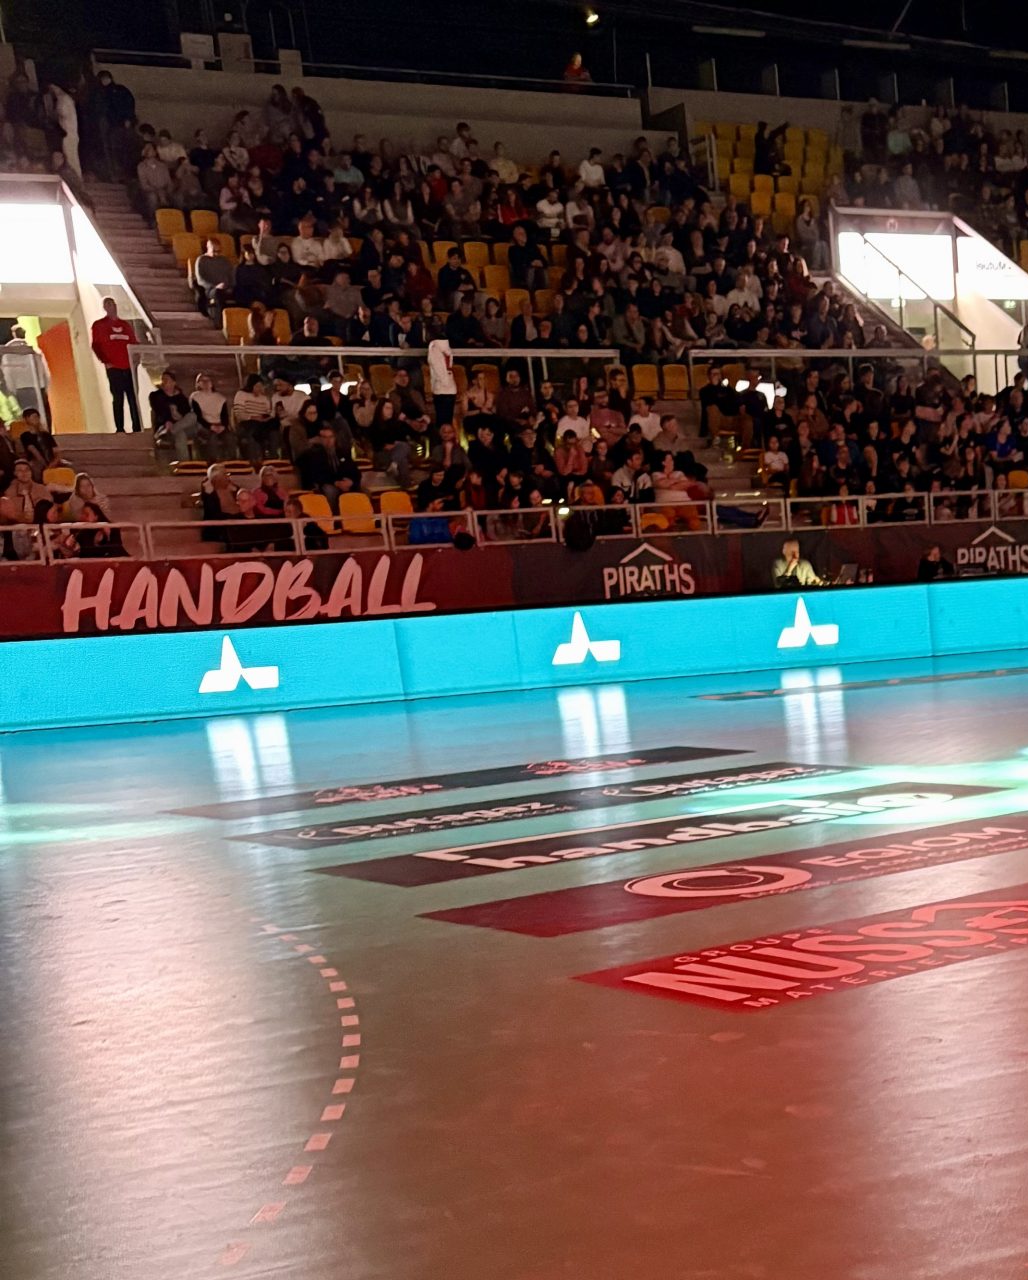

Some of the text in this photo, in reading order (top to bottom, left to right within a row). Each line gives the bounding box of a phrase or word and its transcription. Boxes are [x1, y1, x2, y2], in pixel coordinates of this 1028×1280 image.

[61, 553, 437, 632] HANDBALL
[603, 563, 695, 599] PIRATHS
[800, 826, 1027, 867] EQIOM
[622, 921, 998, 1002] NUSS
[674, 928, 834, 965] GROUPE
